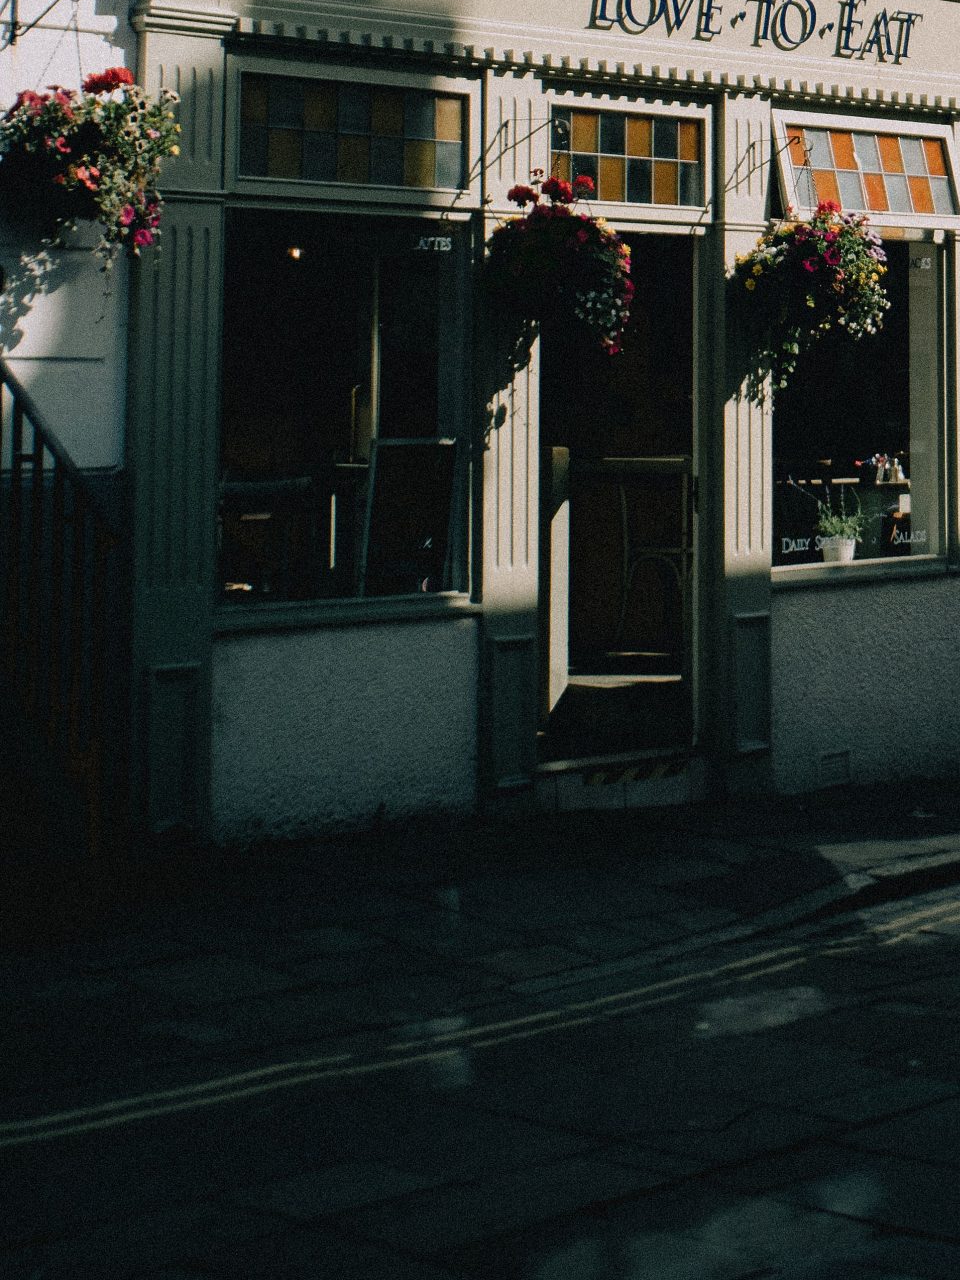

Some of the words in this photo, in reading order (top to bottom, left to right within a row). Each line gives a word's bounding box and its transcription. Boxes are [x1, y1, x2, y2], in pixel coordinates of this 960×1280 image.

[411, 236, 452, 251] ATTES
[781, 536, 811, 554] DAILY
[893, 529, 927, 545] SALADS
